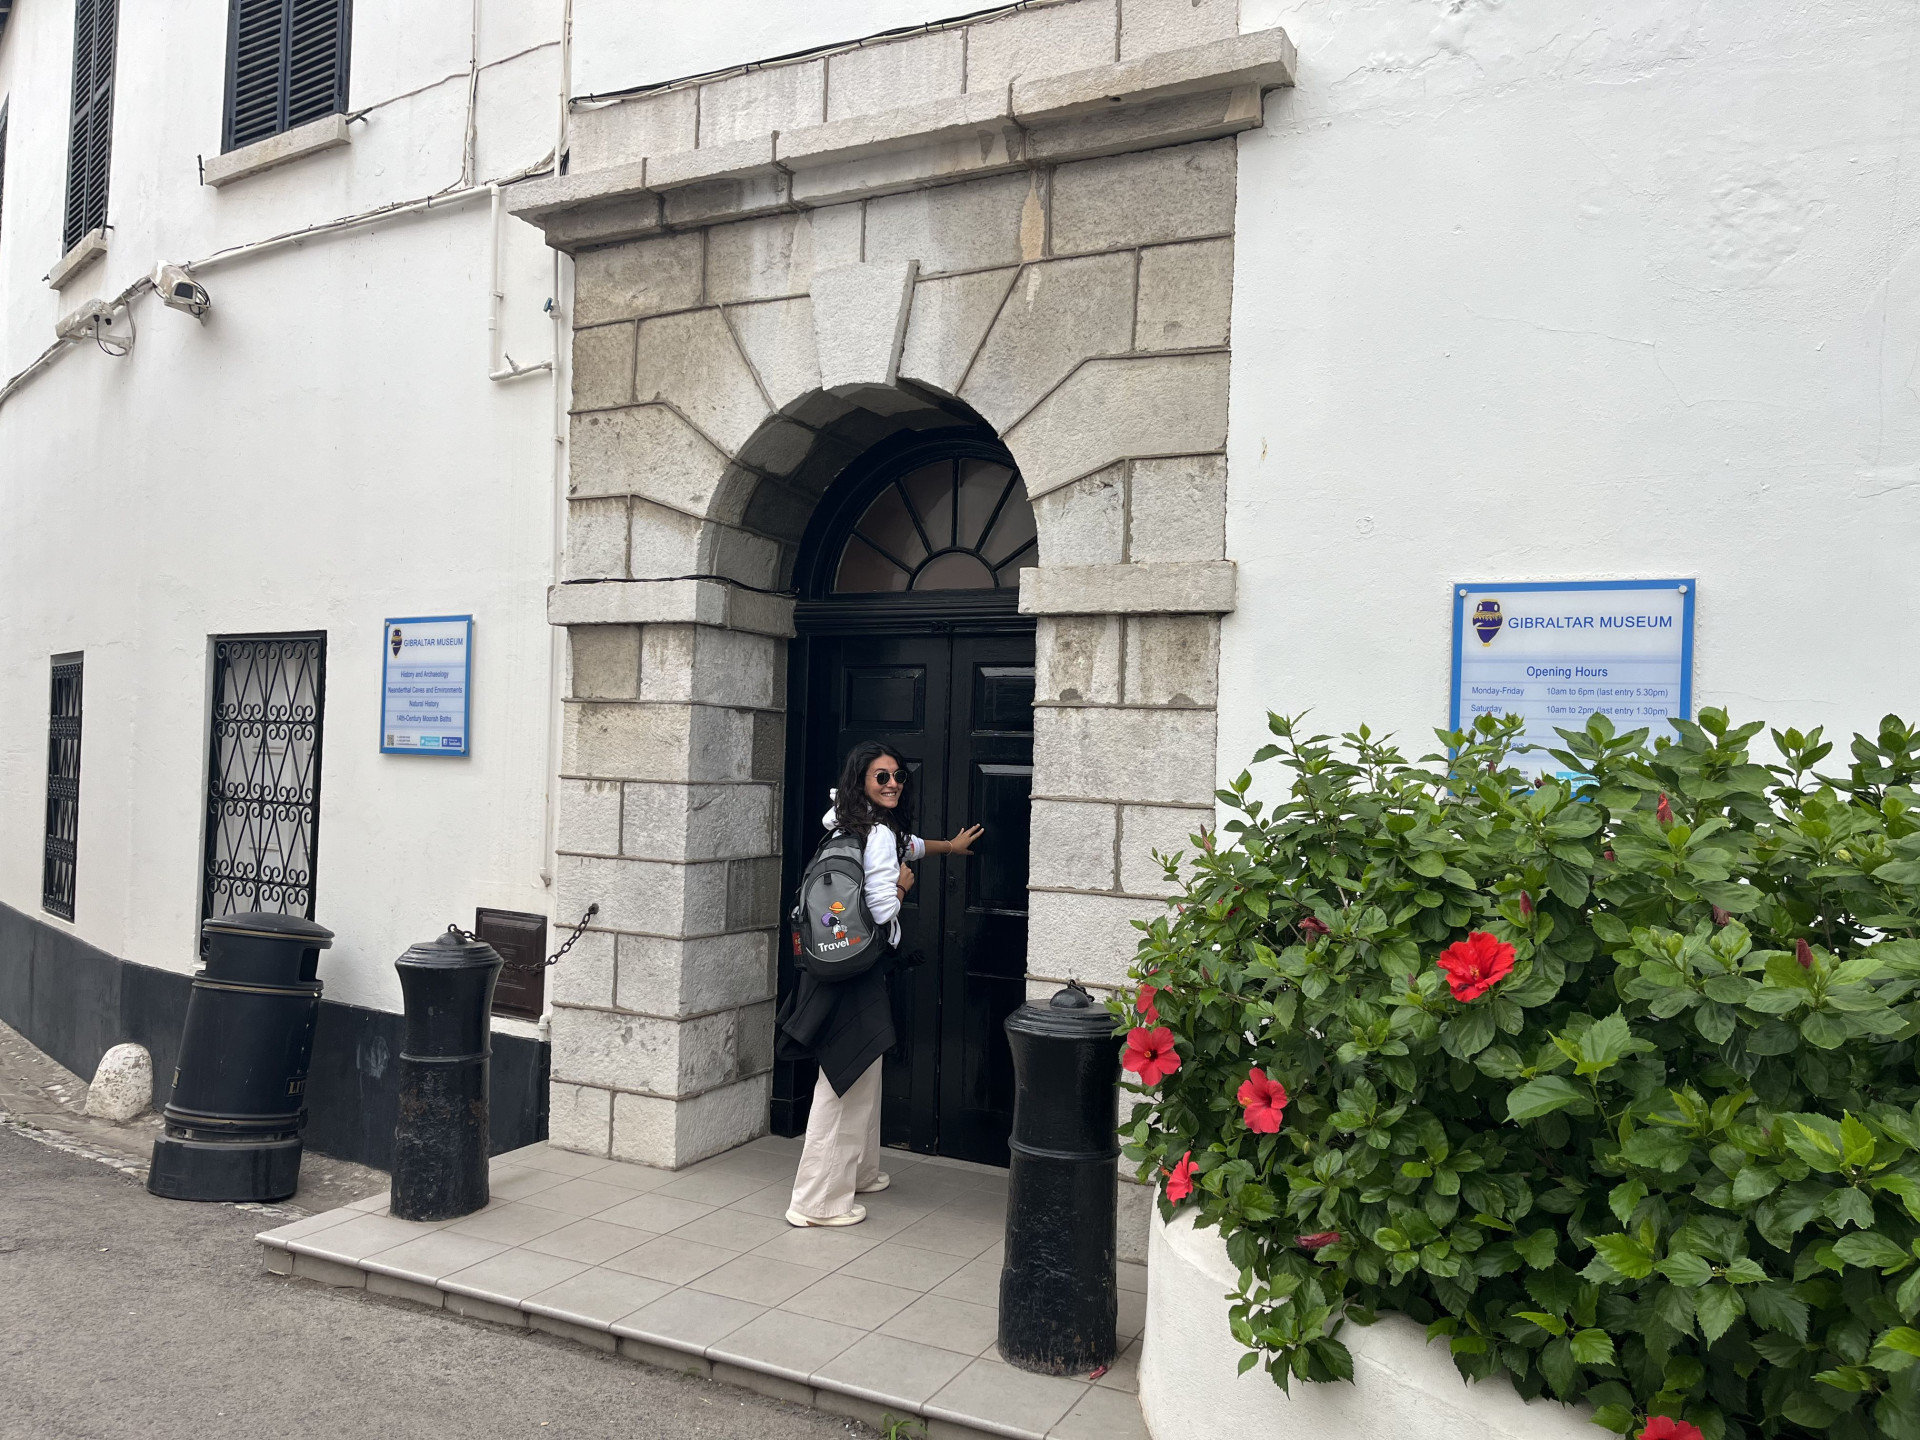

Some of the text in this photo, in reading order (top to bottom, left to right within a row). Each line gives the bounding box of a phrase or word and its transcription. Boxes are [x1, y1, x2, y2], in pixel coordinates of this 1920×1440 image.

[1508, 616, 1672, 629] GIBRALTAR MUSEUM
[437, 637, 463, 646] MUSEUM
[1526, 665, 1608, 679] Opening Hours
[1472, 687, 1668, 698] Monday-Friday 10am to 6pm (last entry 5.30pm)
[425, 700, 439, 708] History
[1471, 705, 1502, 713] Saturday
[1546, 706, 1567, 715] 10am
[1568, 706, 1577, 715] to
[1578, 706, 1594, 716] 2pm
[1615, 708, 1634, 717] entry
[1637, 708, 1668, 717] 1.30pm)
